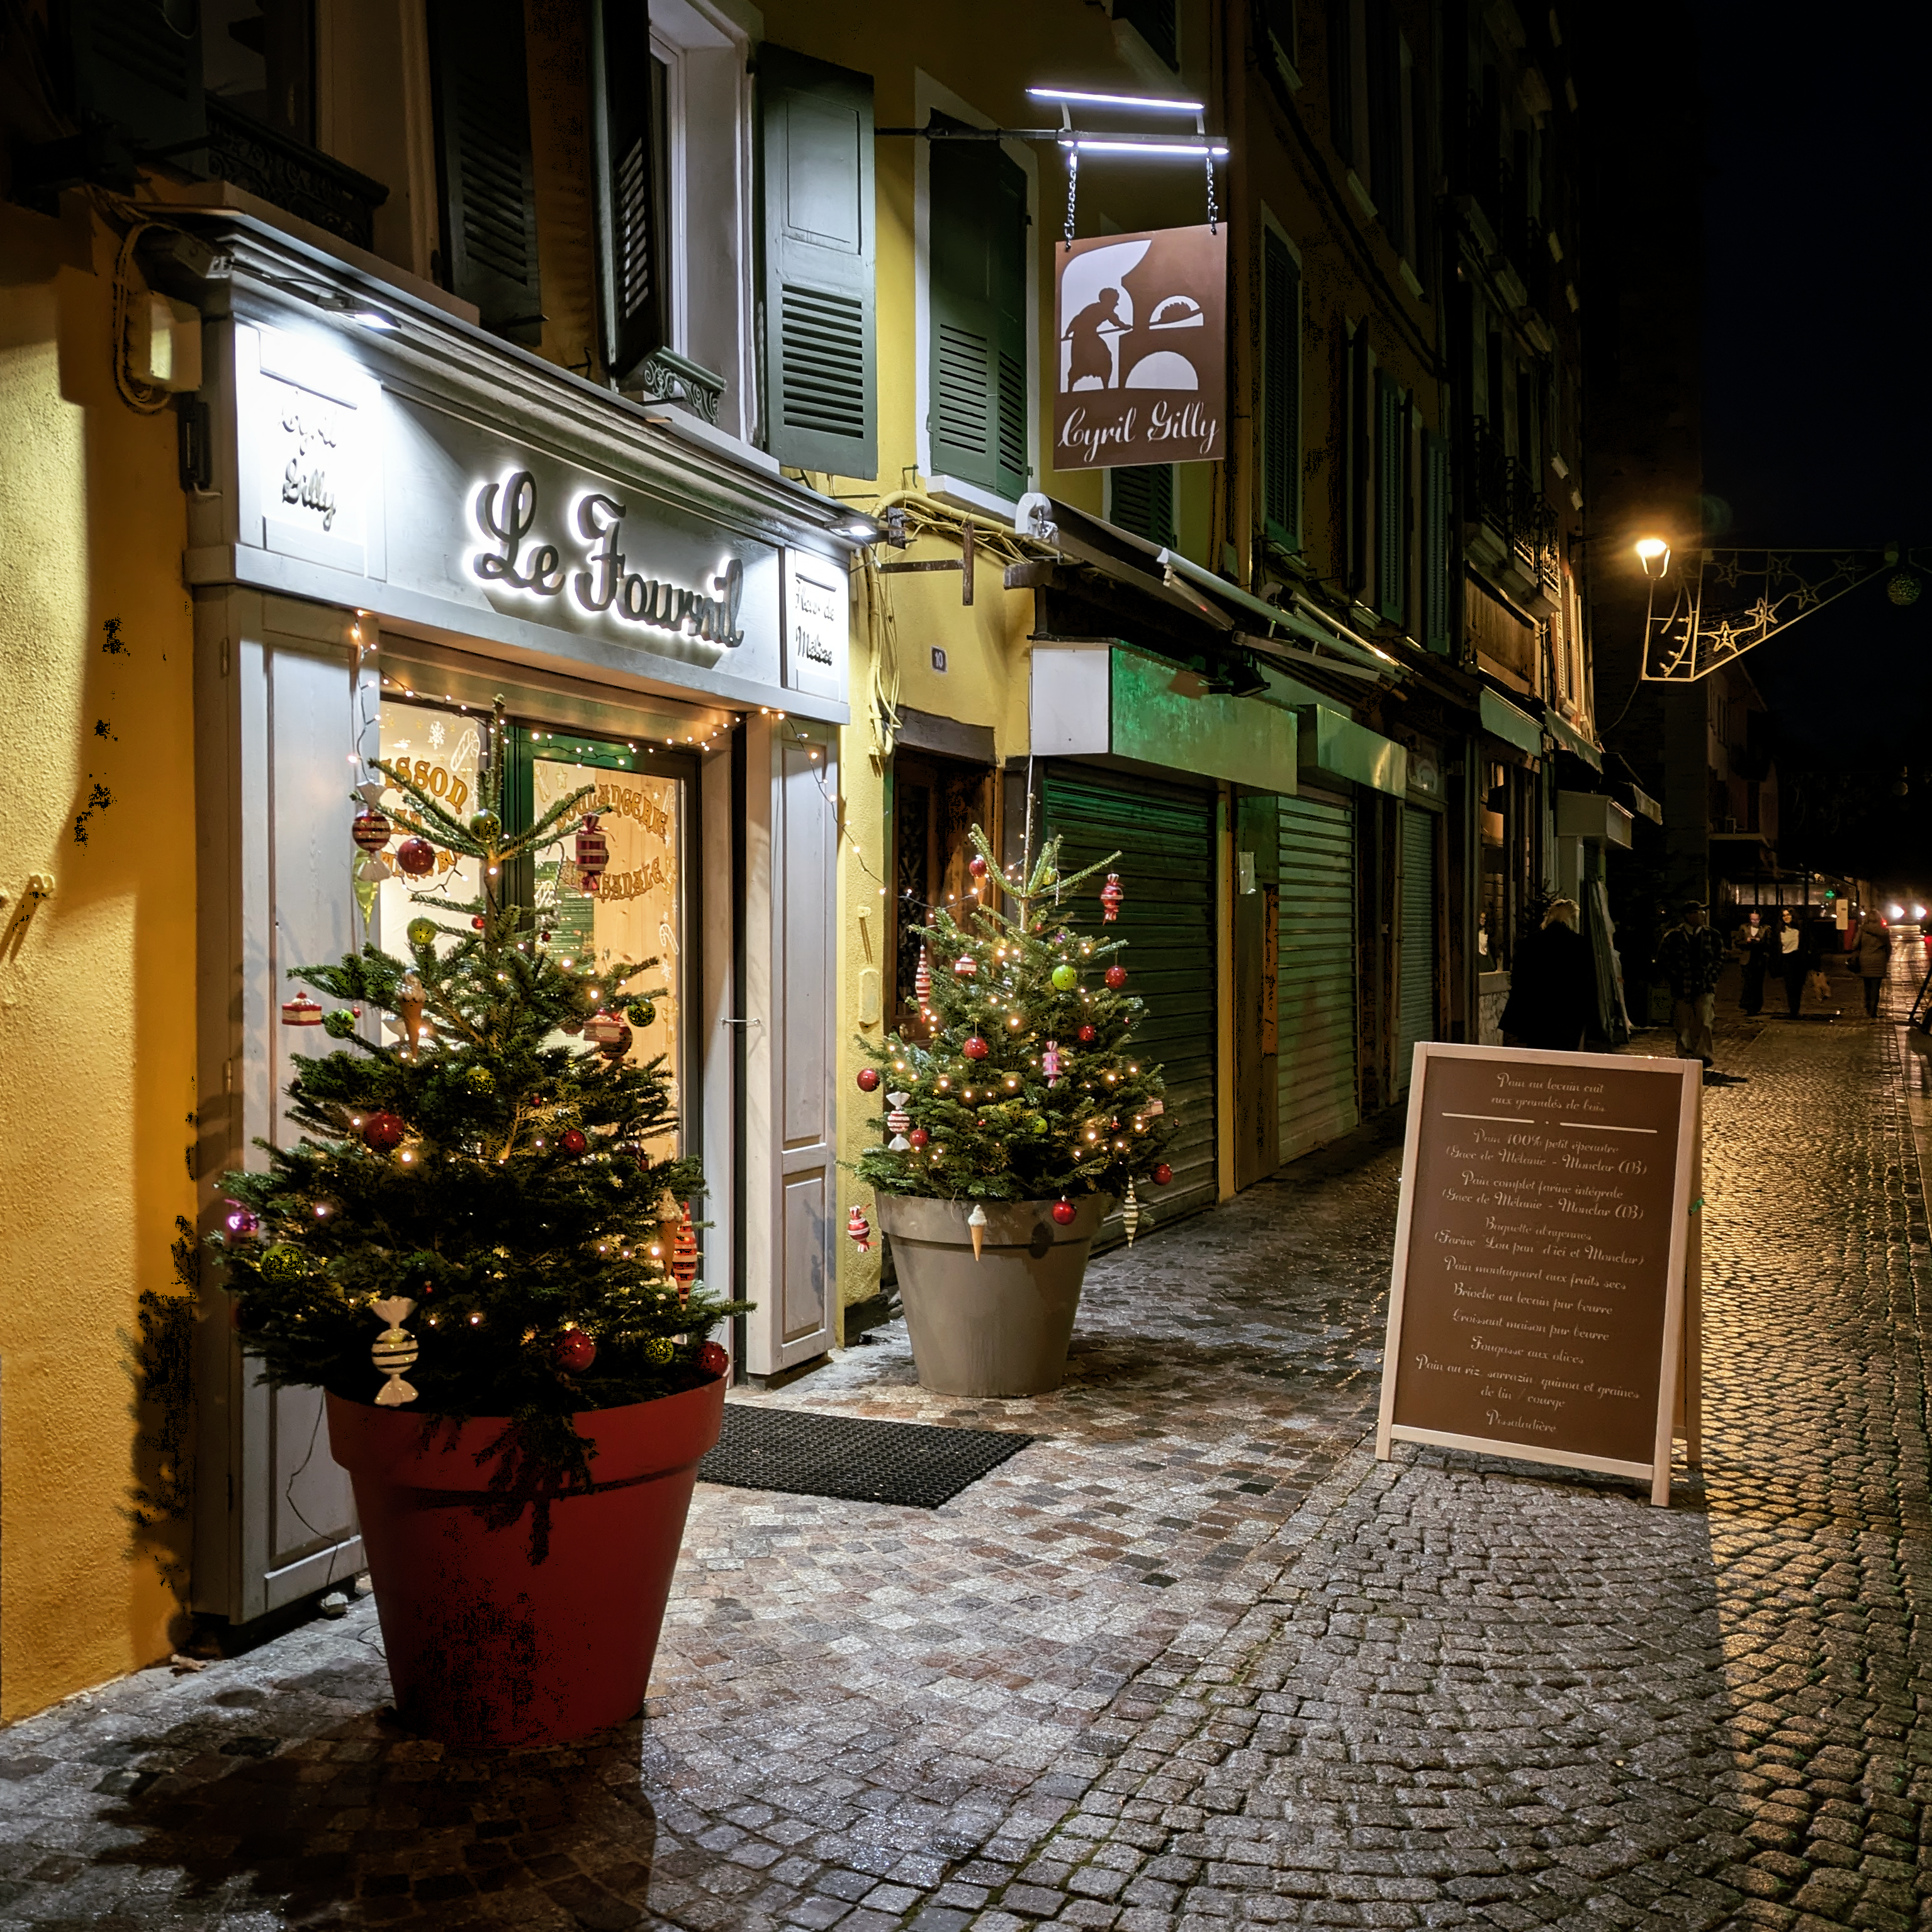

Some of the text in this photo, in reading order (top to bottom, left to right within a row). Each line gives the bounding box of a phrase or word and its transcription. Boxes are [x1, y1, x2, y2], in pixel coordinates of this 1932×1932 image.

[1057, 399, 1220, 463] Cyril Gilly
[282, 458, 337, 532] Gilly
[473, 471, 744, 648] Le Fournil
[935, 651, 943, 668] 10
[1497, 1072, 1603, 1094] Pain au levain cuit
[1491, 1096, 1512, 1105] aux
[1566, 1098, 1580, 1110] de
[1583, 1098, 1606, 1112] bois
[1473, 1128, 1619, 1155] Pain 100% petit épeautre
[1480, 1150, 1494, 1160] de
[1461, 1169, 1625, 1203] Pain complet farine intégrale
[1476, 1193, 1490, 1205] de
[1485, 1216, 1532, 1237] Baguette
[1570, 1249, 1580, 1259] et
[1444, 1255, 1627, 1290] Pain montagnard aux fruits secs
[1453, 1281, 1614, 1315] Brioche au levain pur beurre
[1452, 1307, 1610, 1341] Croissant maison pur beurre
[1470, 1335, 1585, 1364] Fougasse aux olives
[1415, 1353, 1443, 1371] Pain
[1447, 1364, 1461, 1374] au
[1541, 1376, 1580, 1391] quinoa
[1583, 1383, 1595, 1393] et
[1597, 1385, 1640, 1400] graines
[1480, 1385, 1495, 1398] de
[1497, 1386, 1513, 1400] lin
[1527, 1395, 1566, 1412] courge
[1485, 1408, 1558, 1433] Pissaladière
